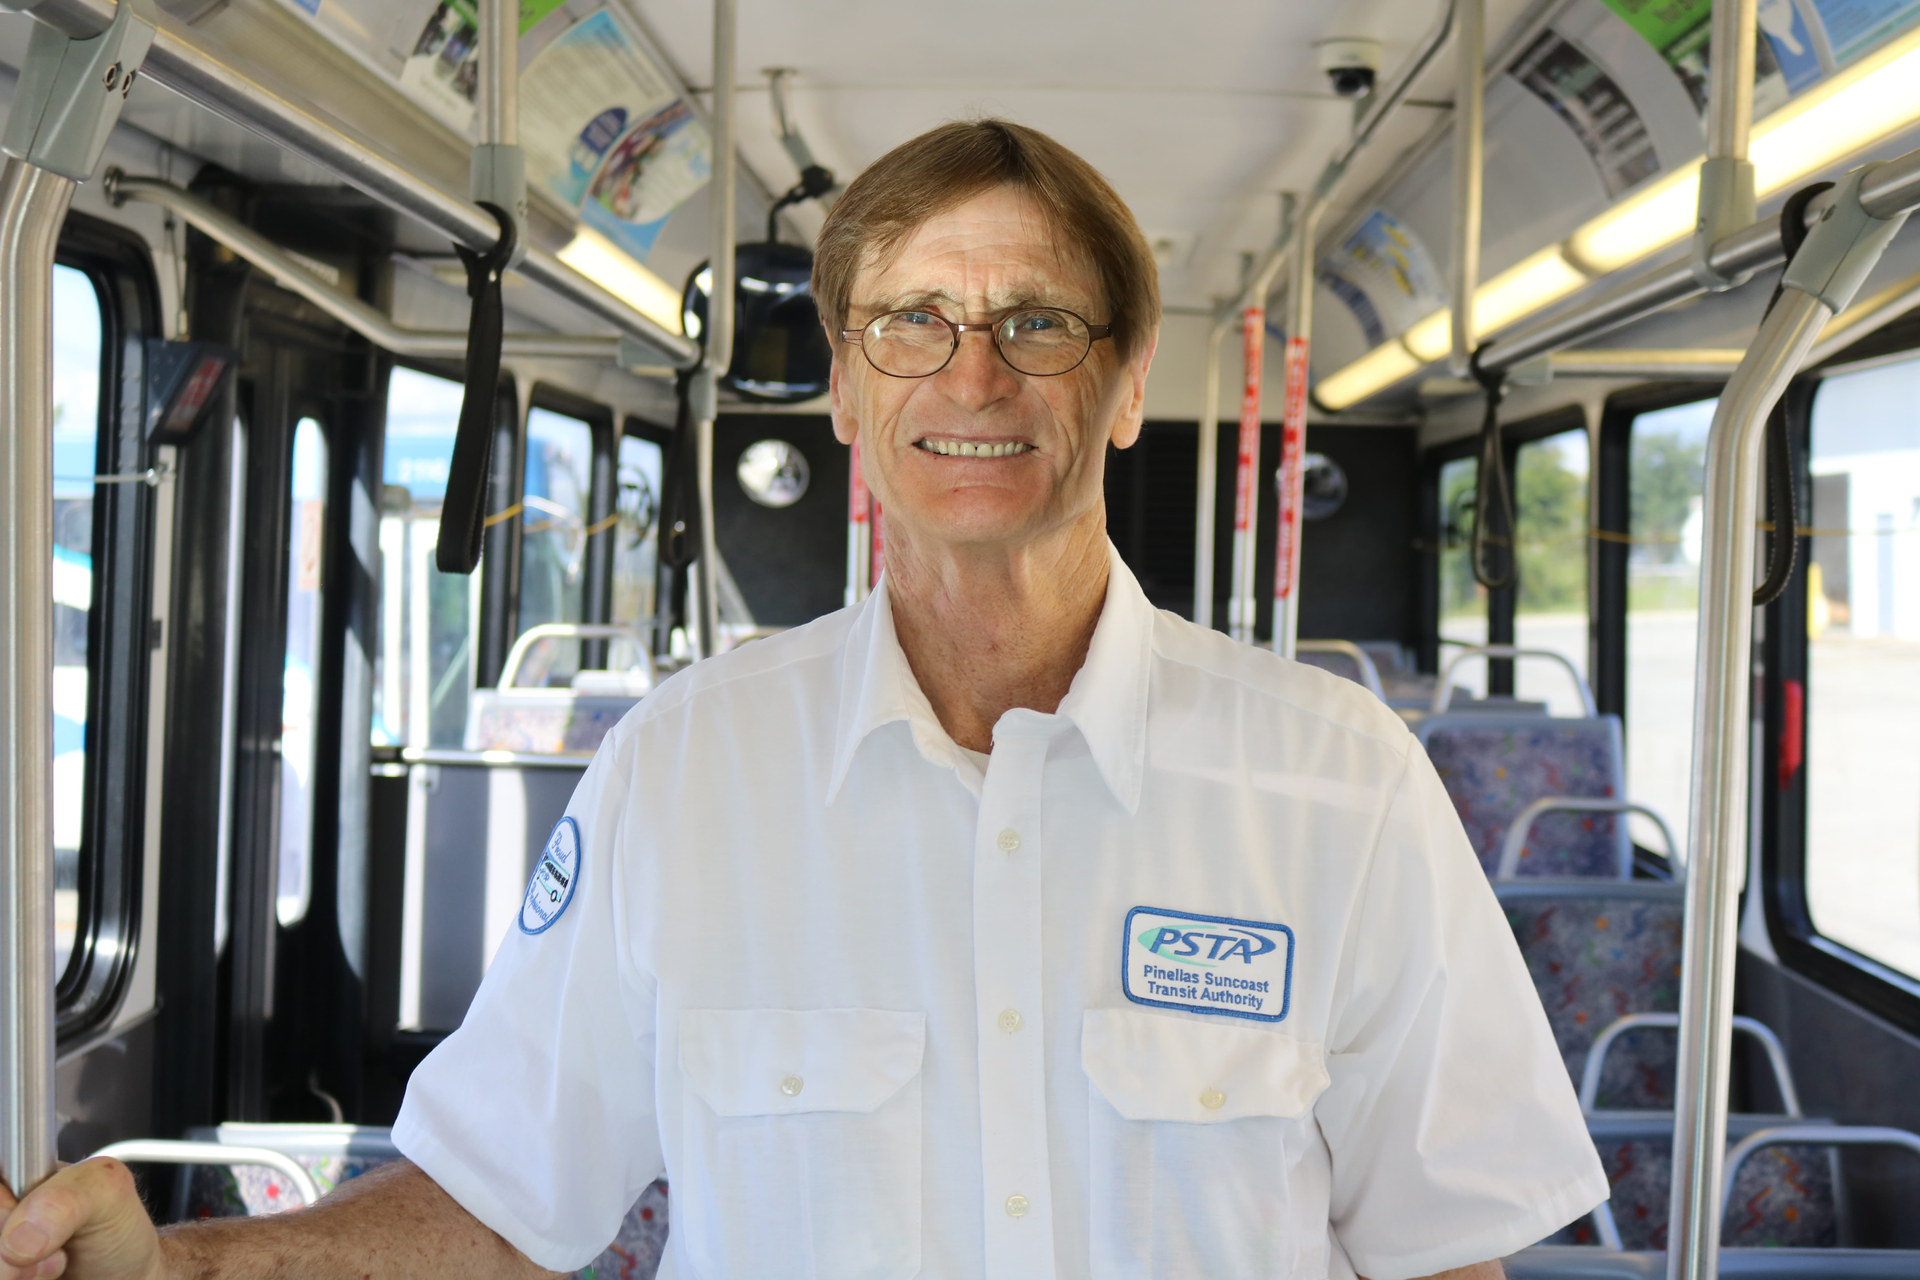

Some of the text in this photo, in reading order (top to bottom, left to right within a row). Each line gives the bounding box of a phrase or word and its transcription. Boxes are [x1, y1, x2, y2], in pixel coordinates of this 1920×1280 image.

[552, 831, 572, 864] Proud
[1149, 927, 1277, 965] PSTA
[1143, 964, 1270, 993] Pinellas Suncoast
[1147, 981, 1263, 1011] Transit Authority
